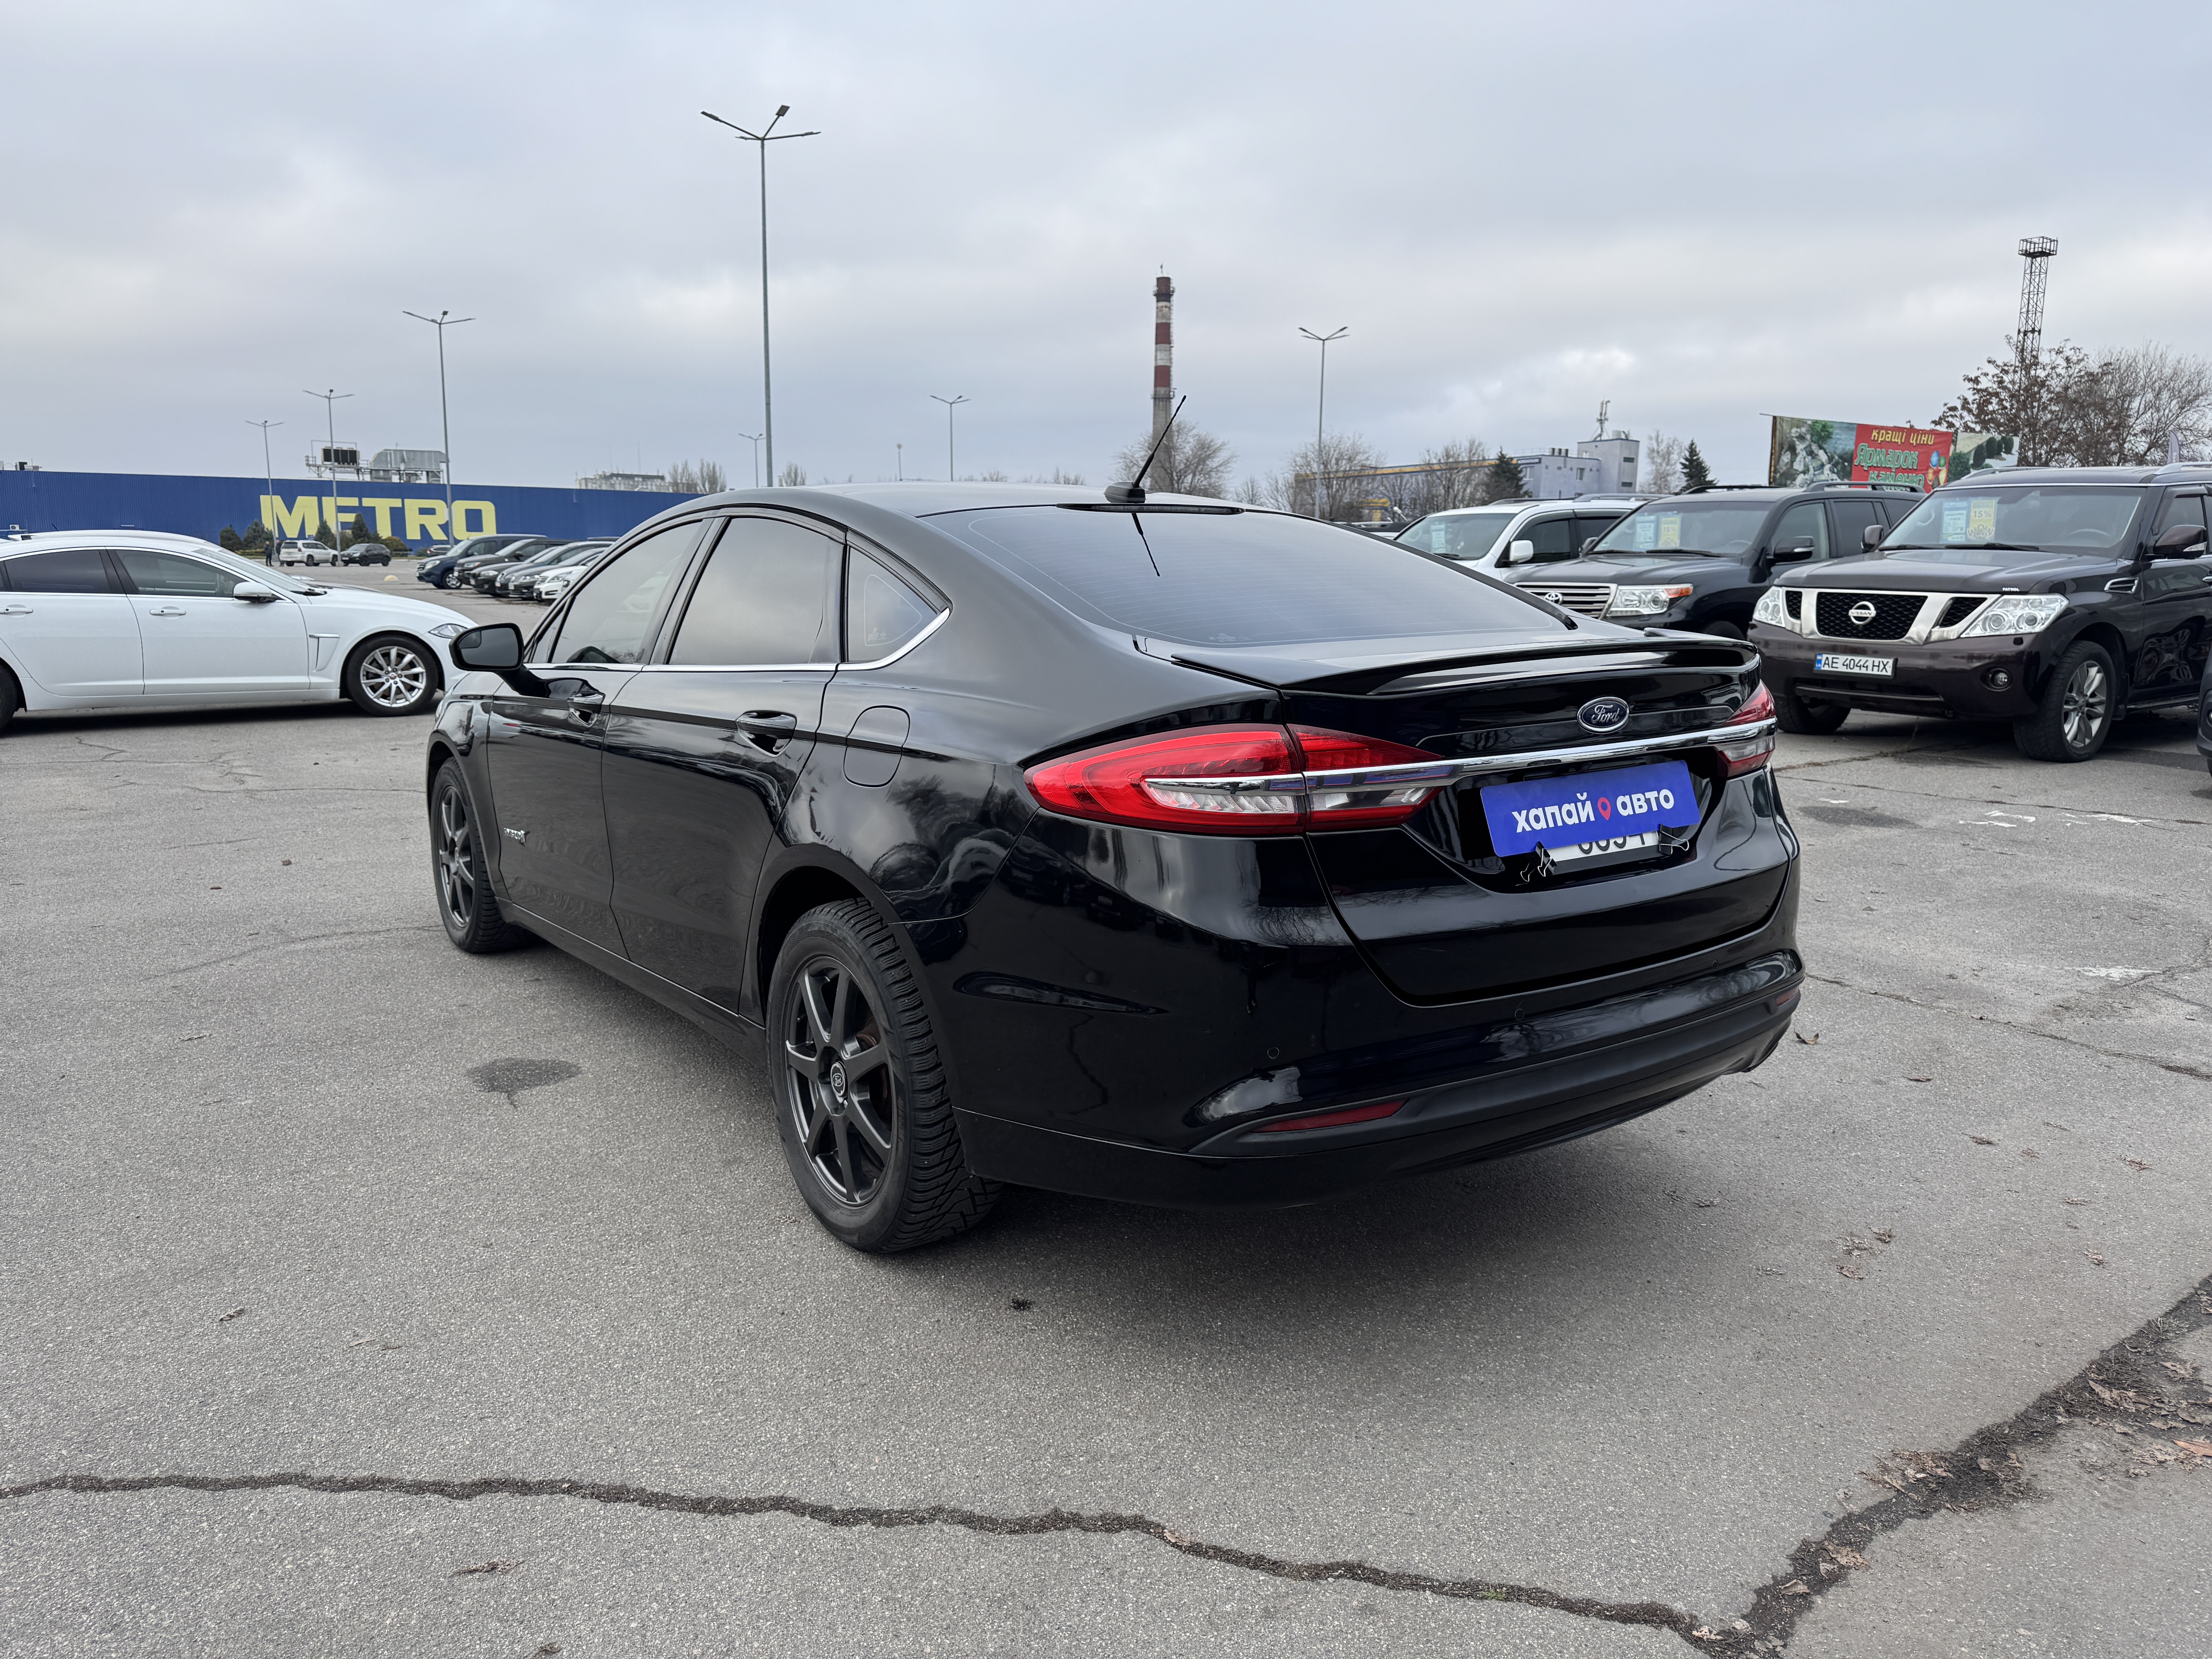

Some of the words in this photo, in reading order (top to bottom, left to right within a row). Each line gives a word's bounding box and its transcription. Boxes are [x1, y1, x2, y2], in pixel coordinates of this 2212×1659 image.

[1871, 429, 1906, 445] кращі
[1909, 431, 1935, 446] ціни
[1854, 443, 1919, 472] Ярмарок
[260, 495, 497, 540] METRO
[1973, 510, 1992, 518] 15%
[1822, 657, 1839, 669] AE
[1842, 658, 1869, 671] 4044
[1872, 660, 1889, 673] HX
[1591, 704, 1620, 724] Ford
[1511, 792, 1595, 833] хапай
[1616, 789, 1674, 816] авто
